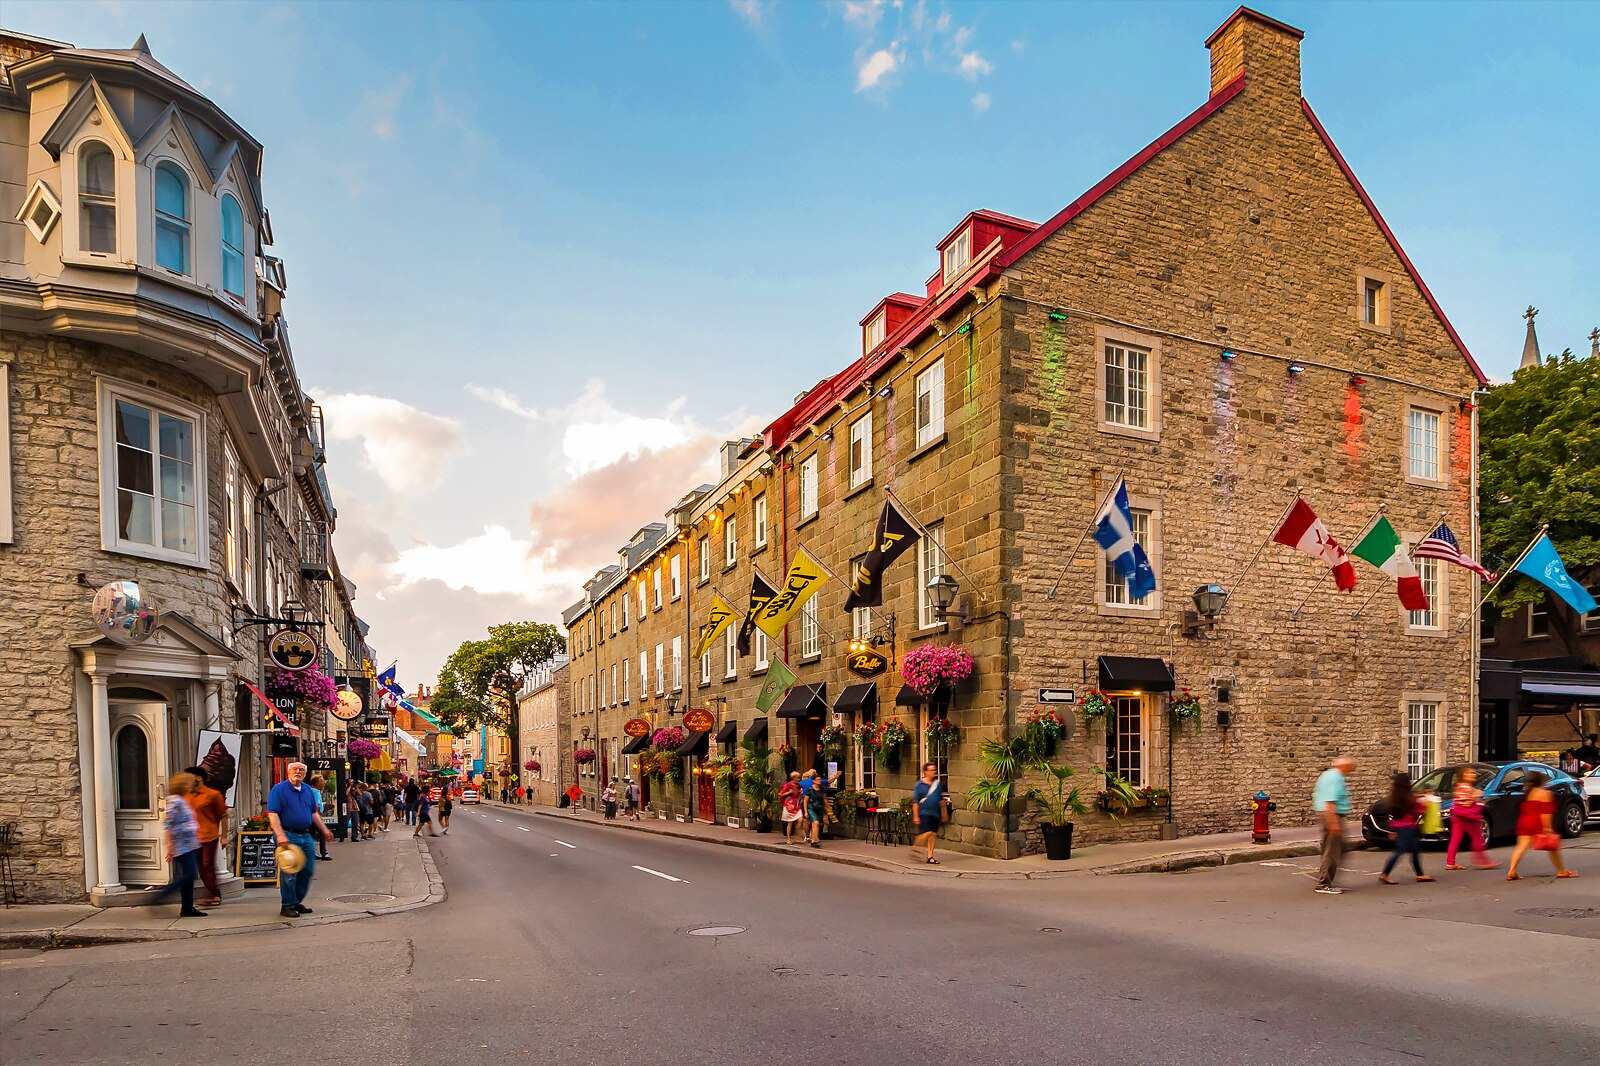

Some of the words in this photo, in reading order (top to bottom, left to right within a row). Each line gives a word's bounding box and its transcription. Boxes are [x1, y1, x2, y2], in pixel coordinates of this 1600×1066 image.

[278, 634, 310, 647] NILI
[853, 655, 882, 670] Bello
[275, 698, 295, 708] LON
[317, 760, 331, 769] 72
